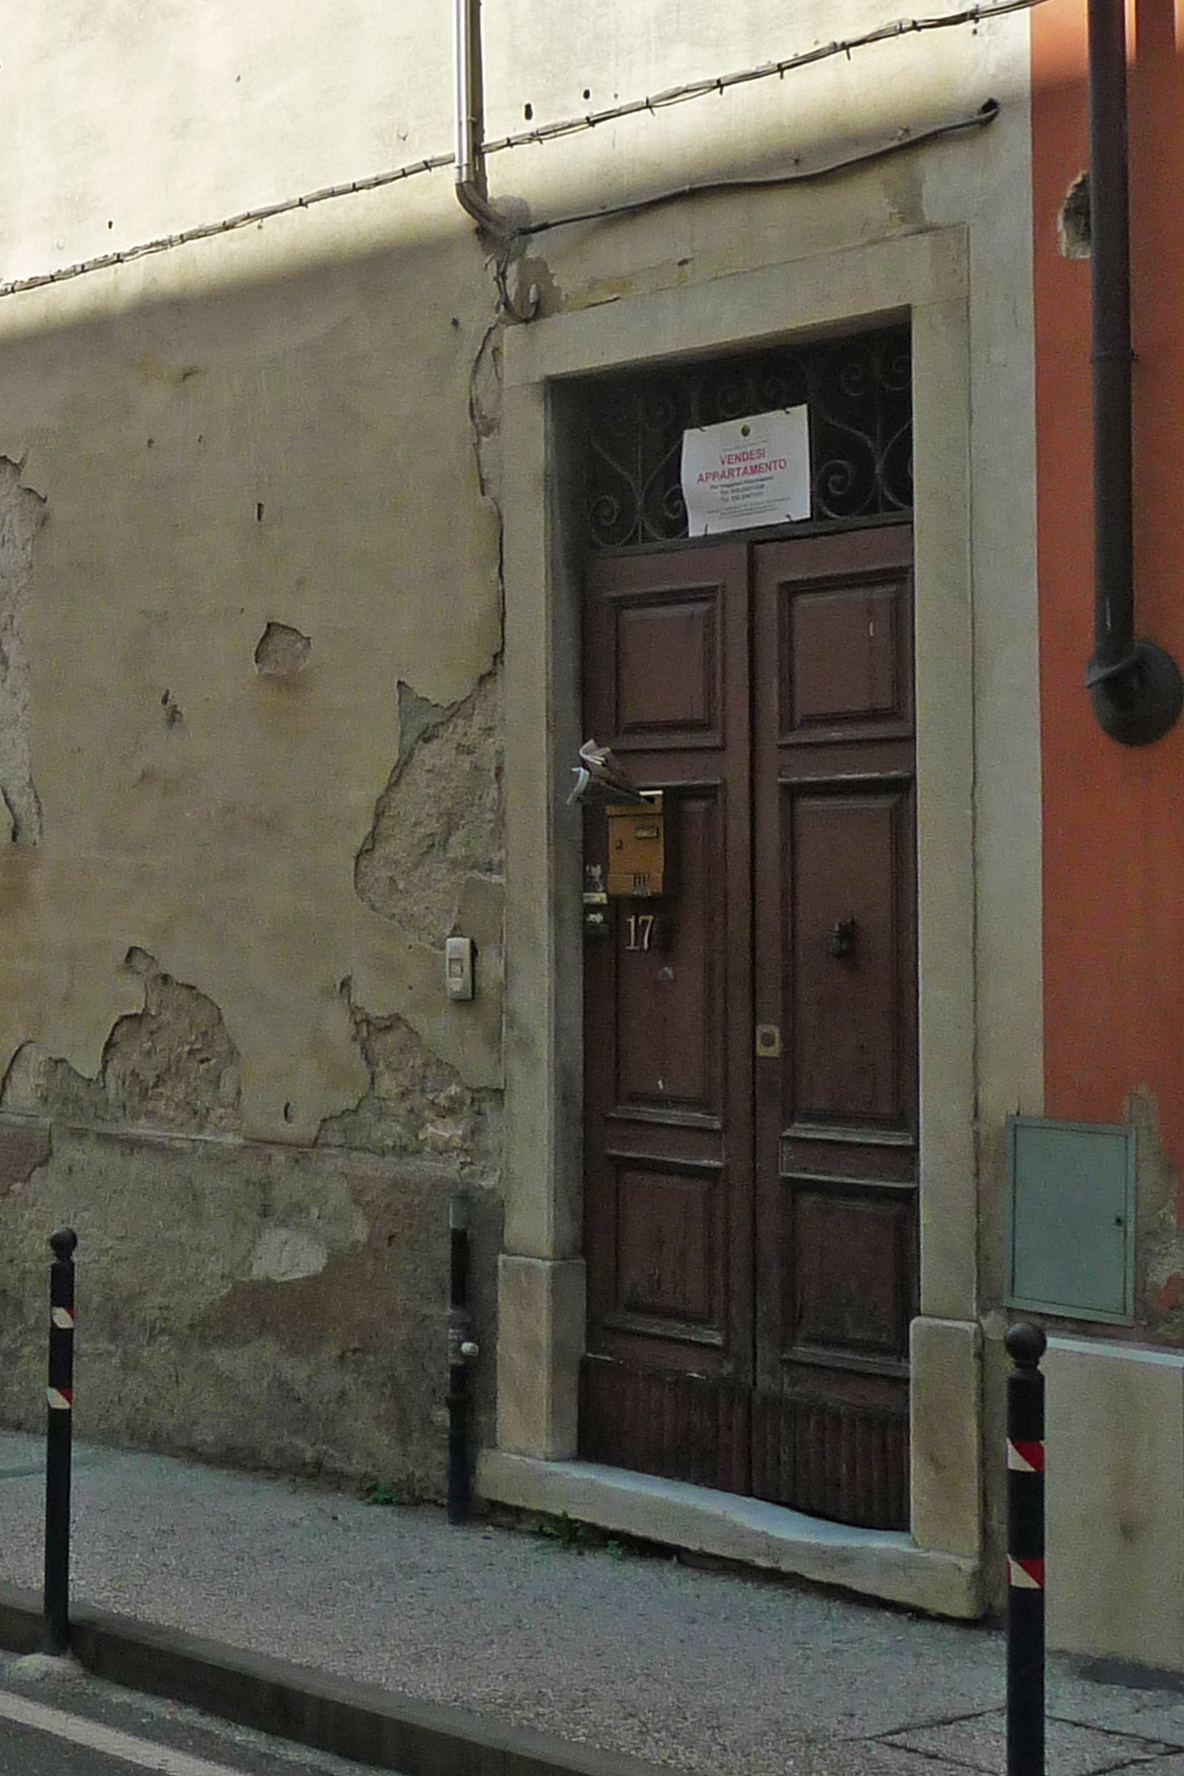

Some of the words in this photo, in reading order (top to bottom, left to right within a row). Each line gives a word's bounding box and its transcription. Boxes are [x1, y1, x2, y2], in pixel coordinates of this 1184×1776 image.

[720, 448, 766, 466] VENDESI
[696, 458, 787, 484] APPARTAMENTO
[626, 915, 654, 951] 17
